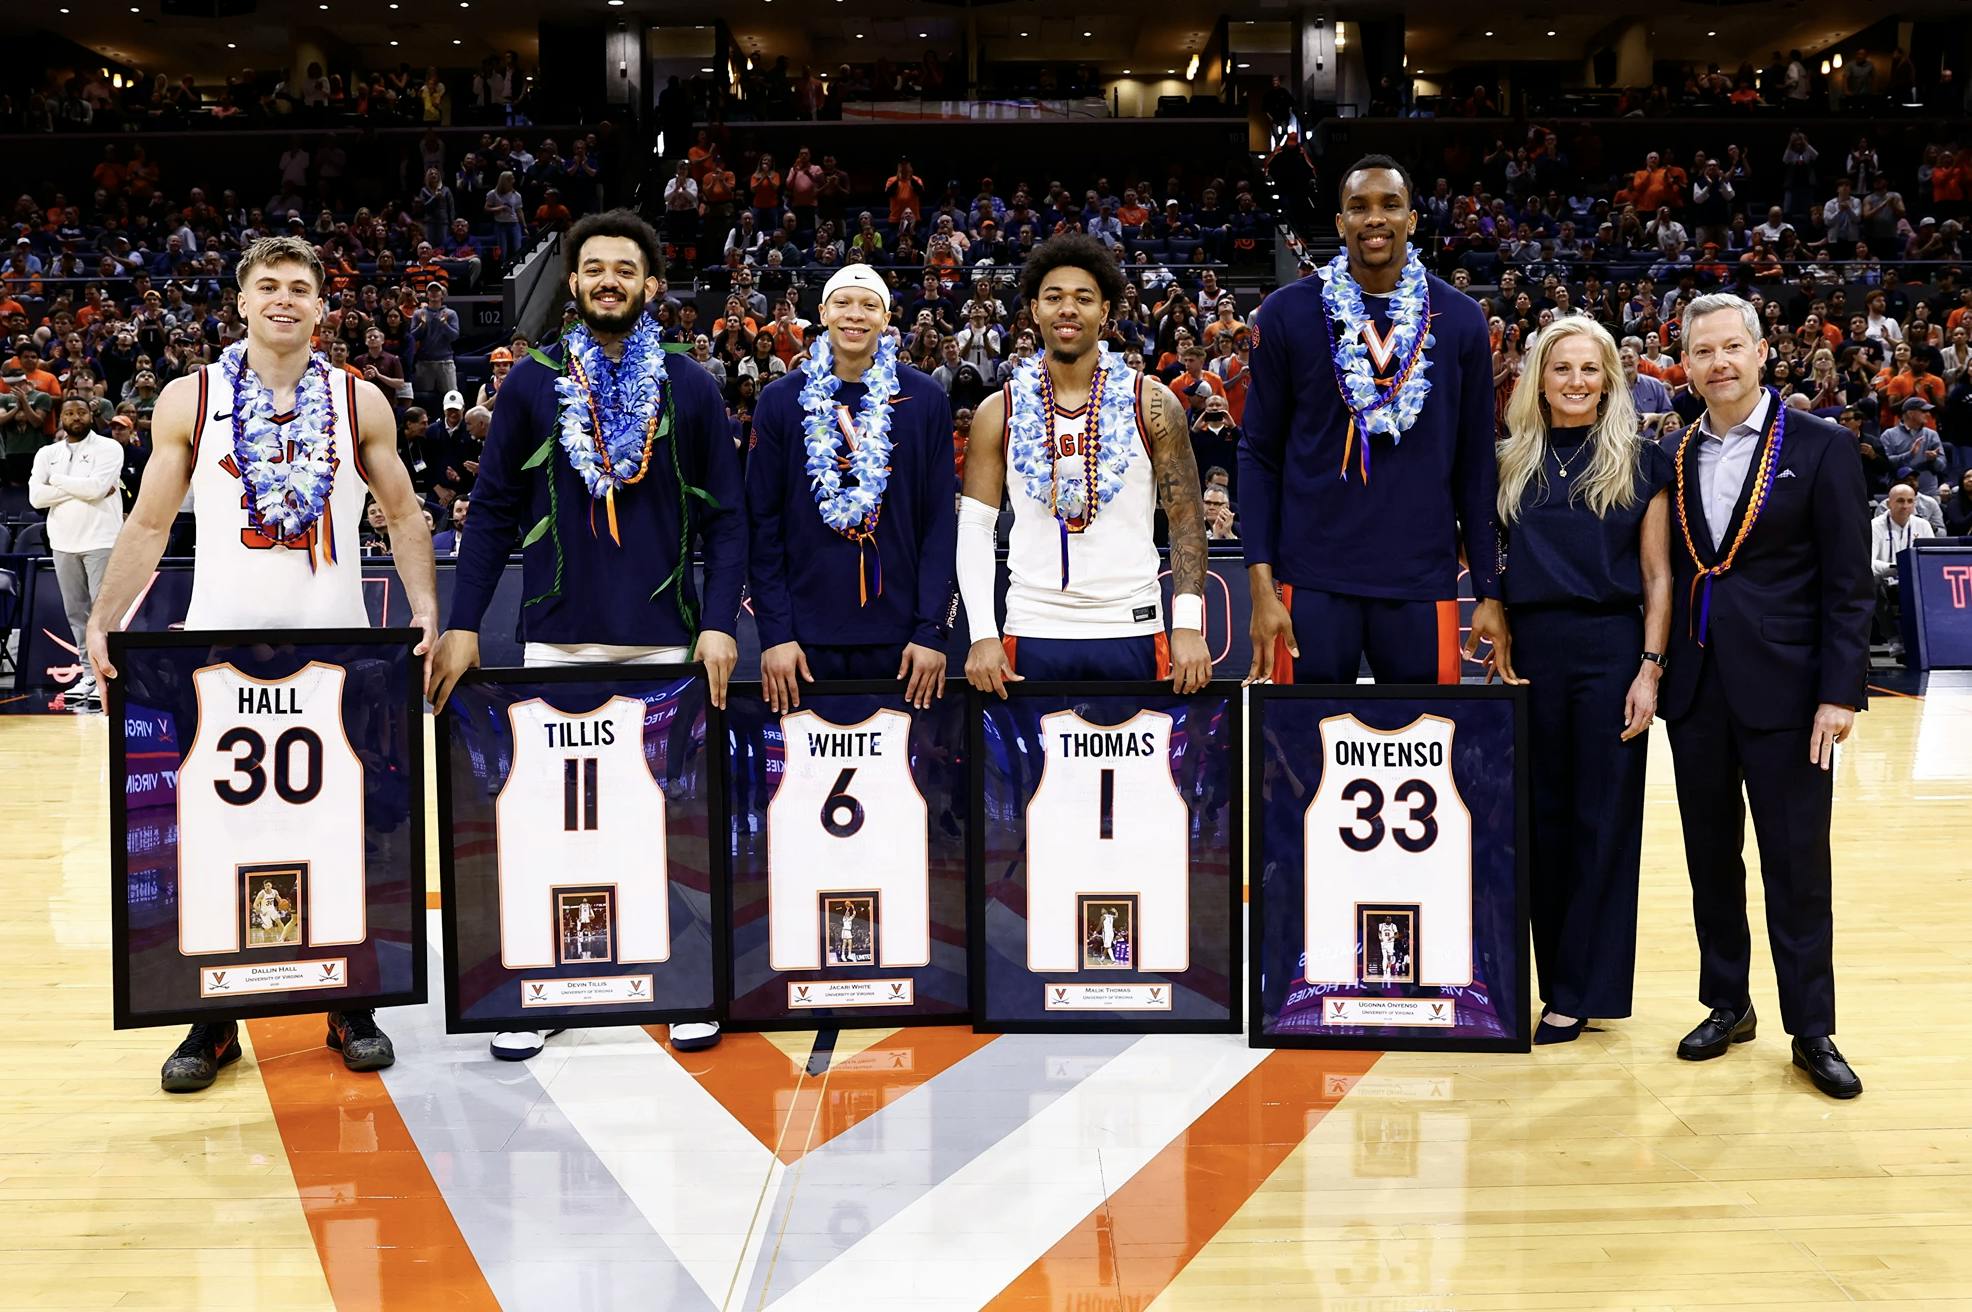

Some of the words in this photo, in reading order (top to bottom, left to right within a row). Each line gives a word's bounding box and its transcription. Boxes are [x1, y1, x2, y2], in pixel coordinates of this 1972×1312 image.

[480, 311, 500, 324] 102
[238, 687, 303, 715] HALL
[544, 719, 615, 748] TILLIS
[808, 732, 882, 757] WHITE
[1060, 732, 1155, 758] THOMAS
[213, 726, 324, 806] 30
[1335, 740, 1443, 767] ONYENSO
[564, 757, 598, 831] 11
[820, 767, 865, 838] 6
[1099, 768, 1115, 840] 1
[1338, 778, 1439, 853] 33
[245, 975, 274, 983] UNIVERSITY
[251, 967, 277, 975] DALLIN
